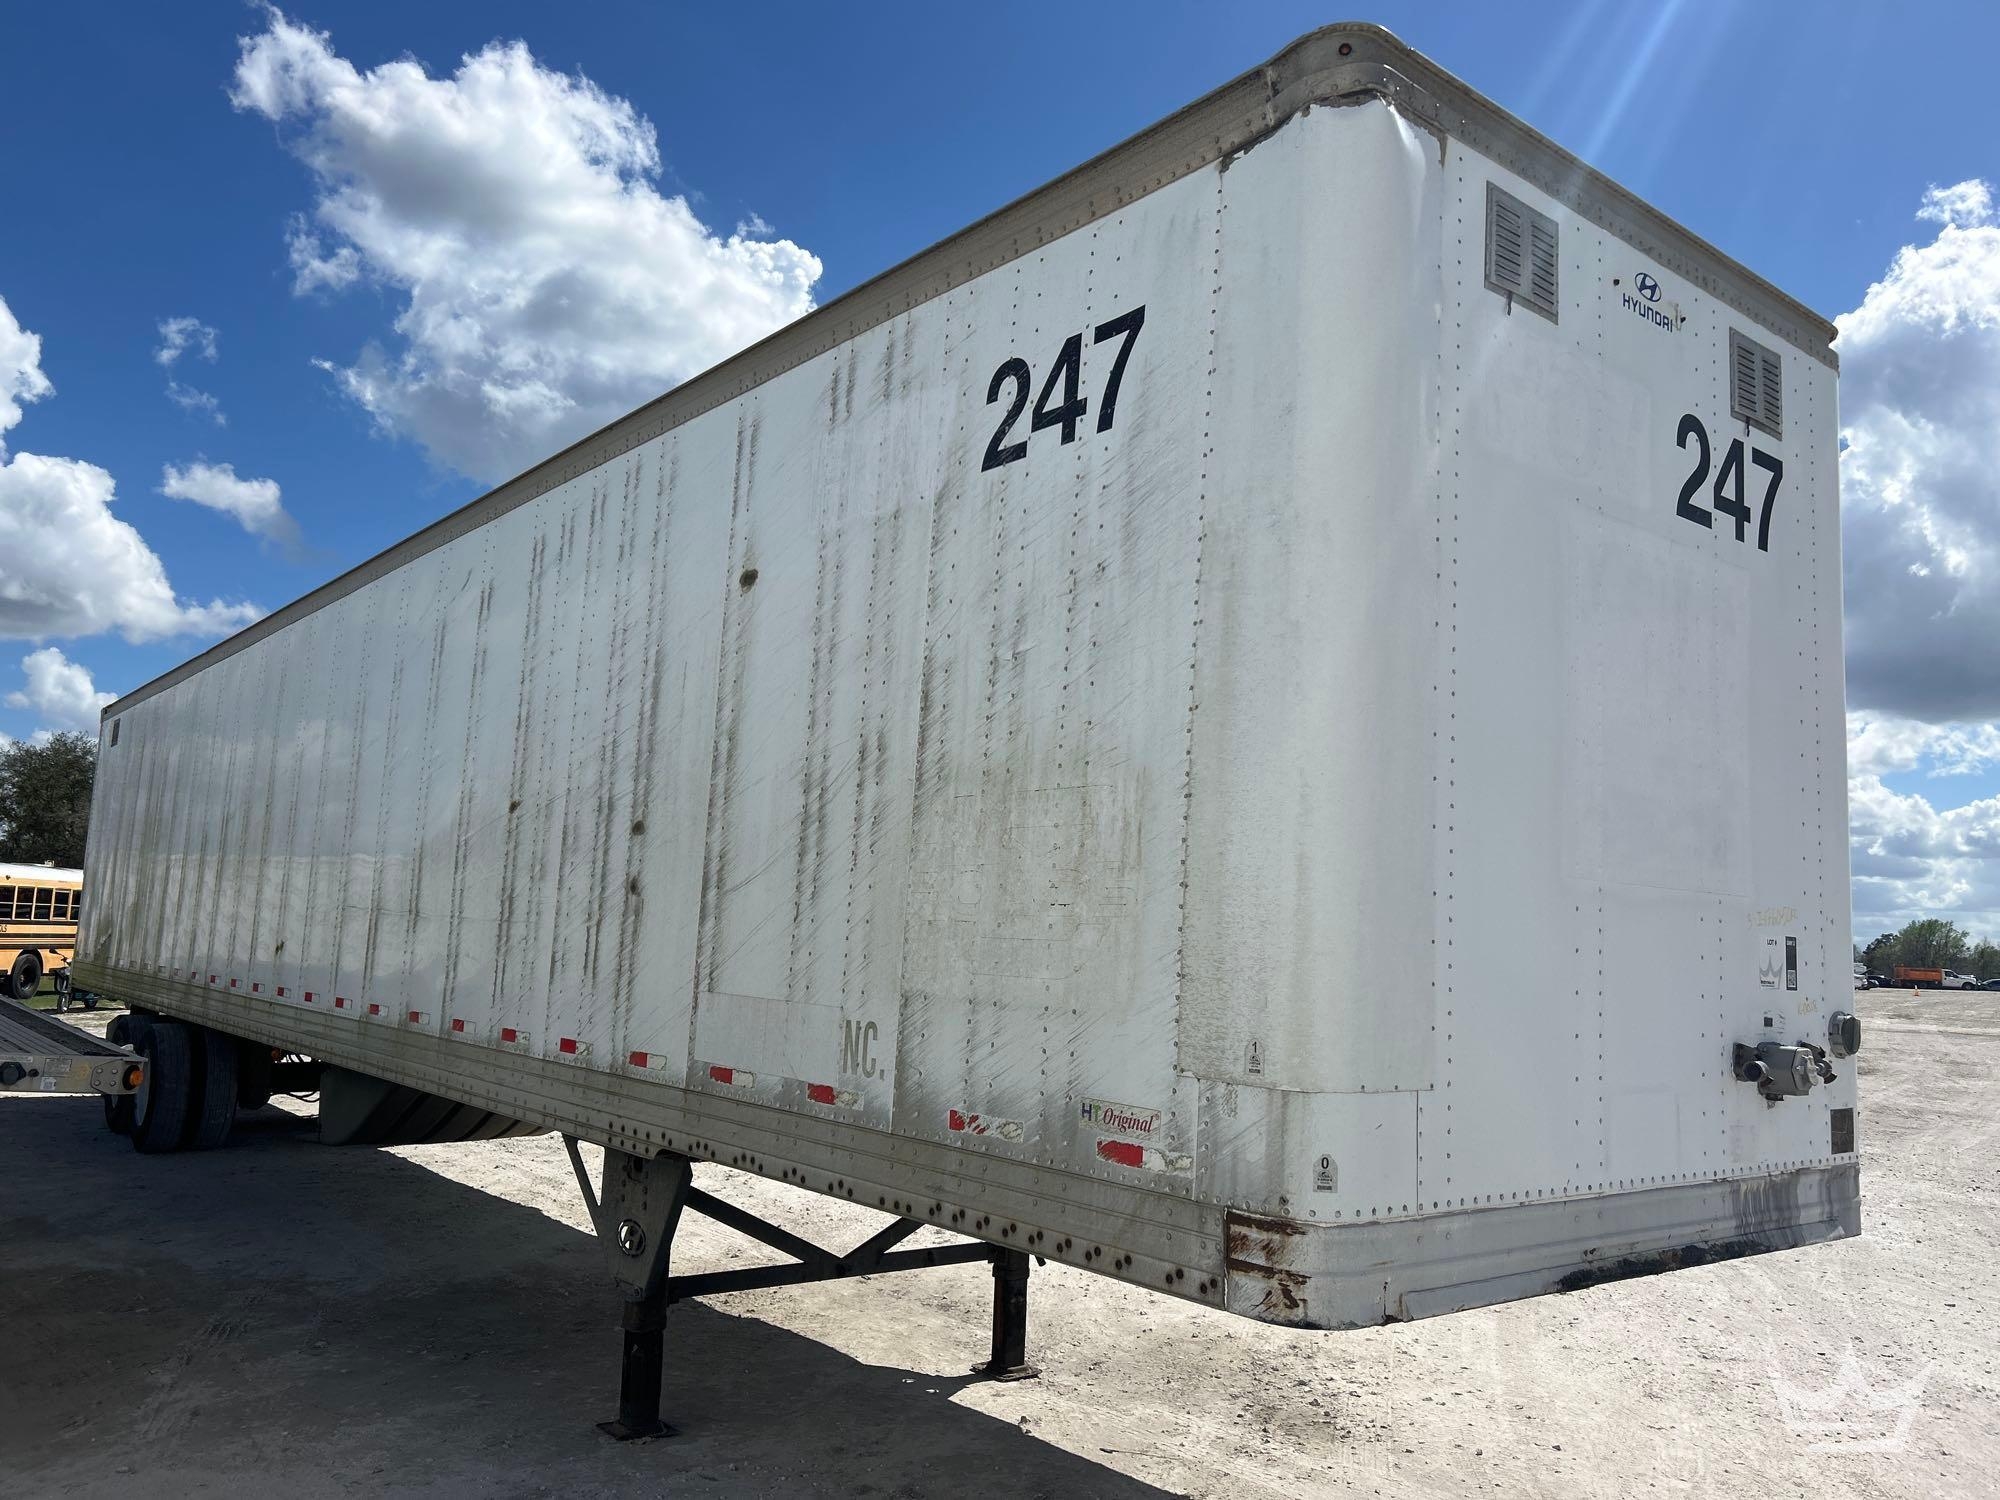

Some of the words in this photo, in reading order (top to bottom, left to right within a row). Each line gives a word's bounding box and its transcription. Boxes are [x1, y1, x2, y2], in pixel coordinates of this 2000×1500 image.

[1622, 292, 1673, 333] HYUNDAI
[981, 304, 1146, 473] 247
[1676, 414, 1784, 553] 247
[1251, 1041, 1258, 1054] 1
[1081, 1102, 1101, 1122] HT
[1103, 1107, 1154, 1133] Original
[1320, 1156, 1330, 1170] 0
